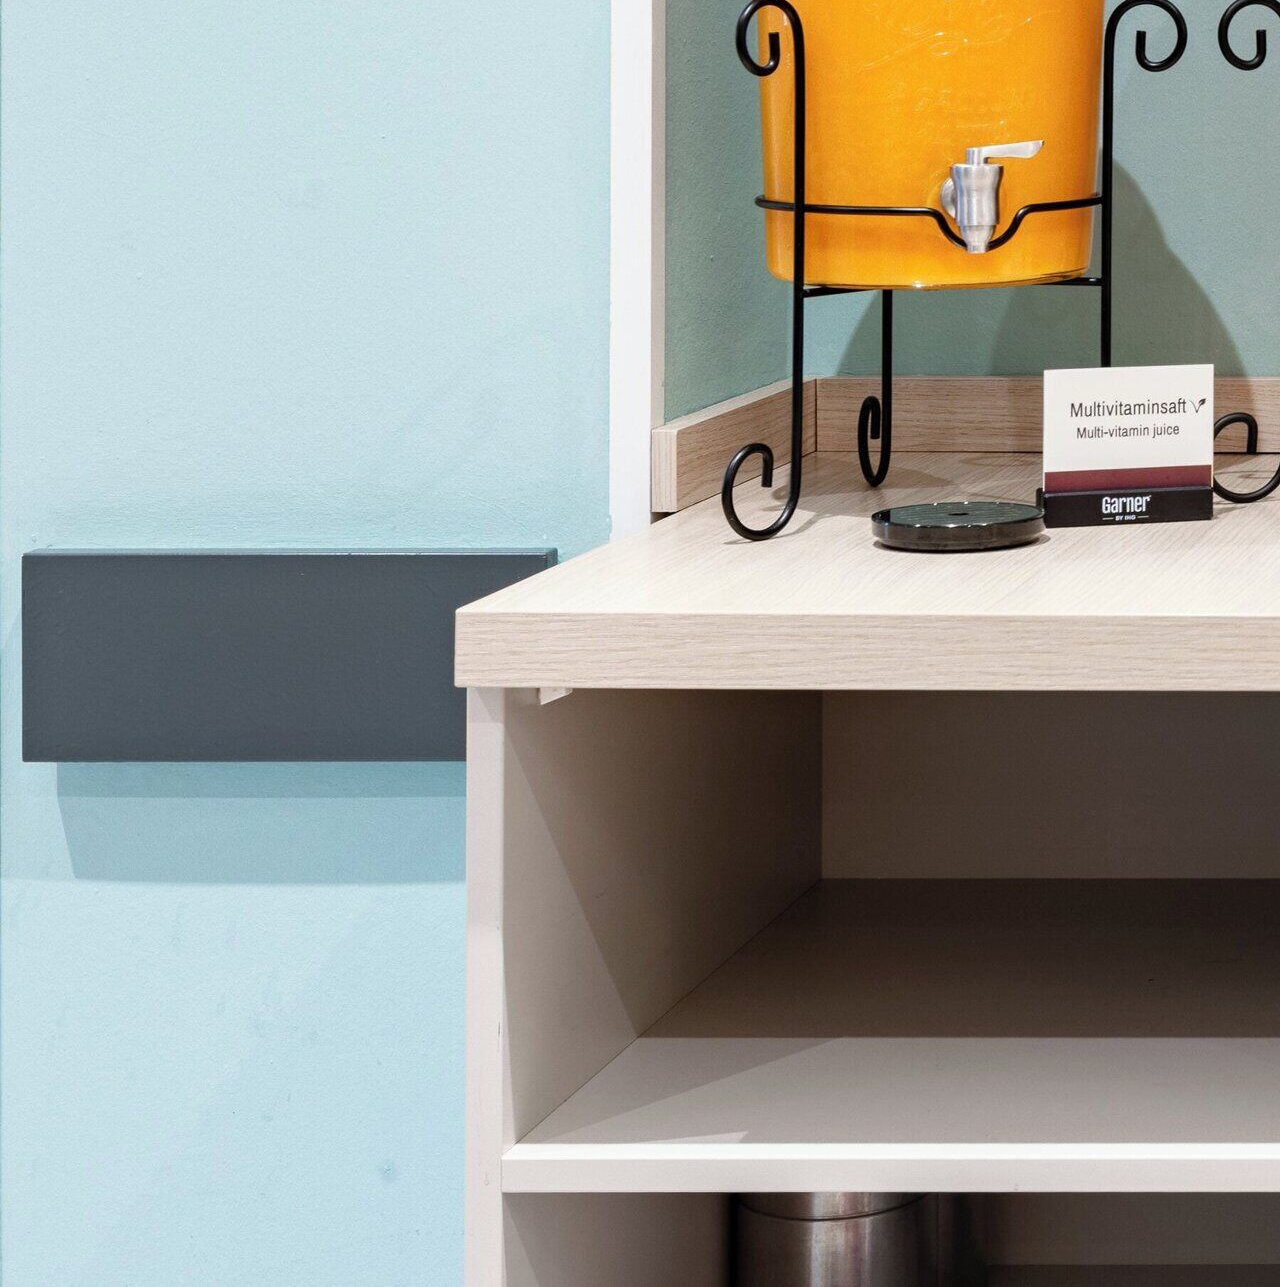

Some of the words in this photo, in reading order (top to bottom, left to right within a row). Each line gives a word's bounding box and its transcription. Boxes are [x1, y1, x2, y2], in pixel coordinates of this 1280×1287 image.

[1070, 397, 1187, 418] Multivitaminsaft
[1076, 424, 1150, 439] Multi-vitamin
[1152, 423, 1180, 438] juice
[1102, 496, 1150, 514] Garner
